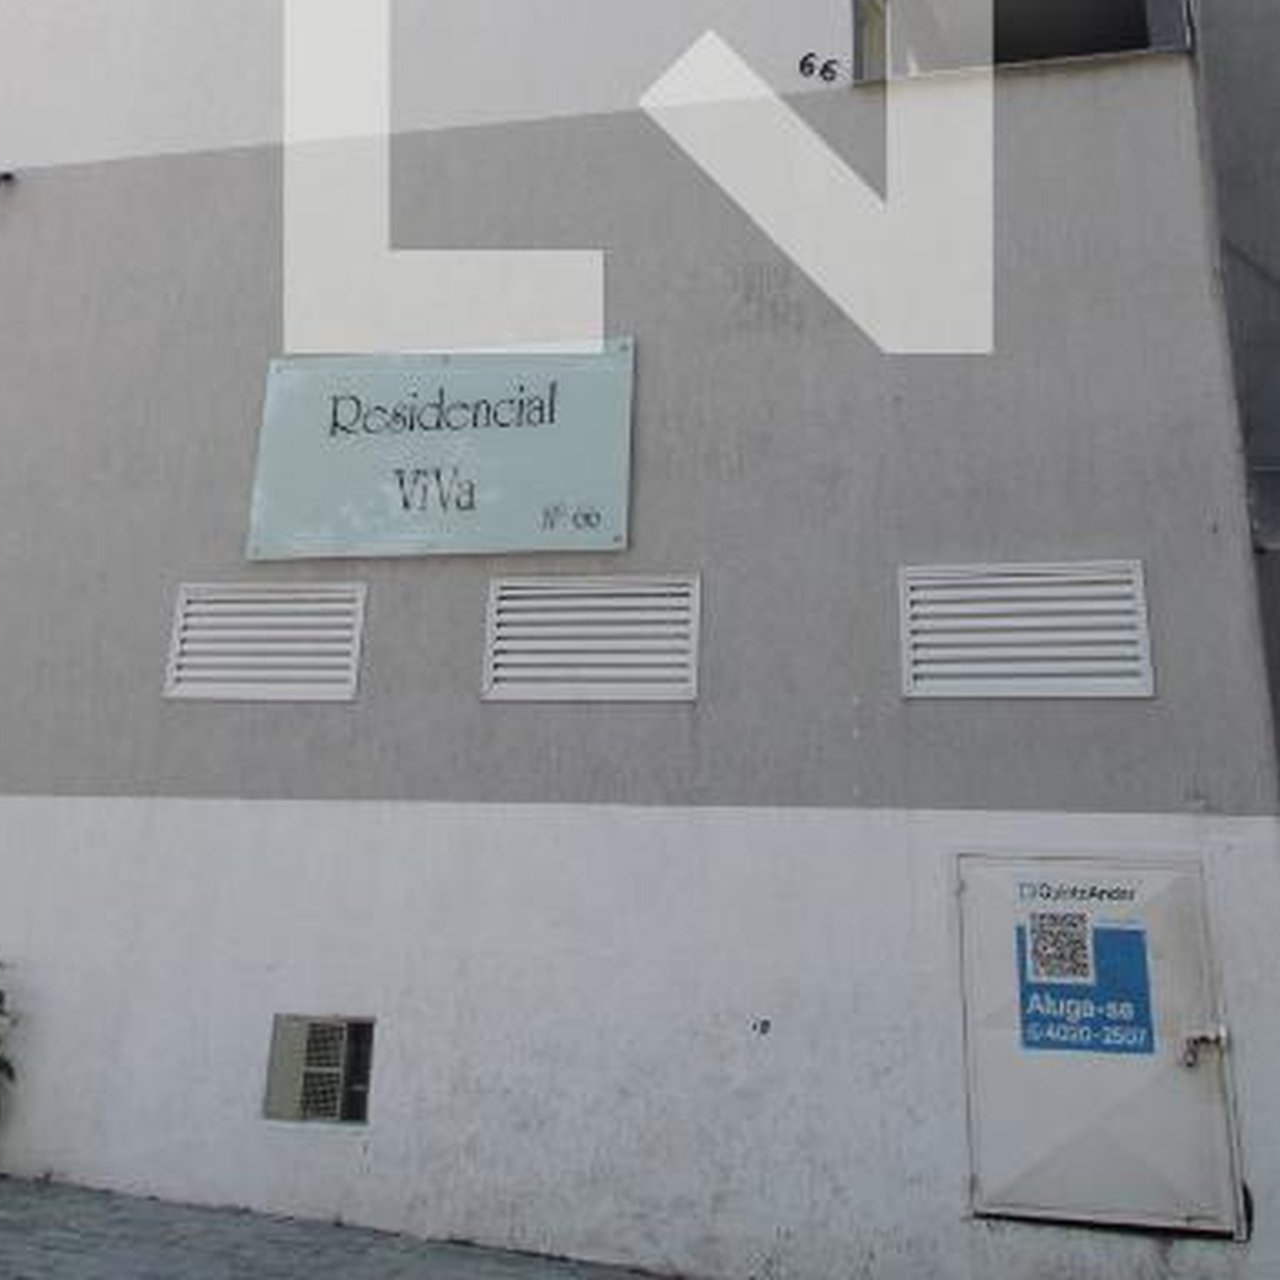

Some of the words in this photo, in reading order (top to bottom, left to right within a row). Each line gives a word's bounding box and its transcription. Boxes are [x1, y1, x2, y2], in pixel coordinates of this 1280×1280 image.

[799, 51, 838, 81] 66
[328, 381, 558, 437] Residencial
[1025, 991, 1135, 1023] Aluga-se
